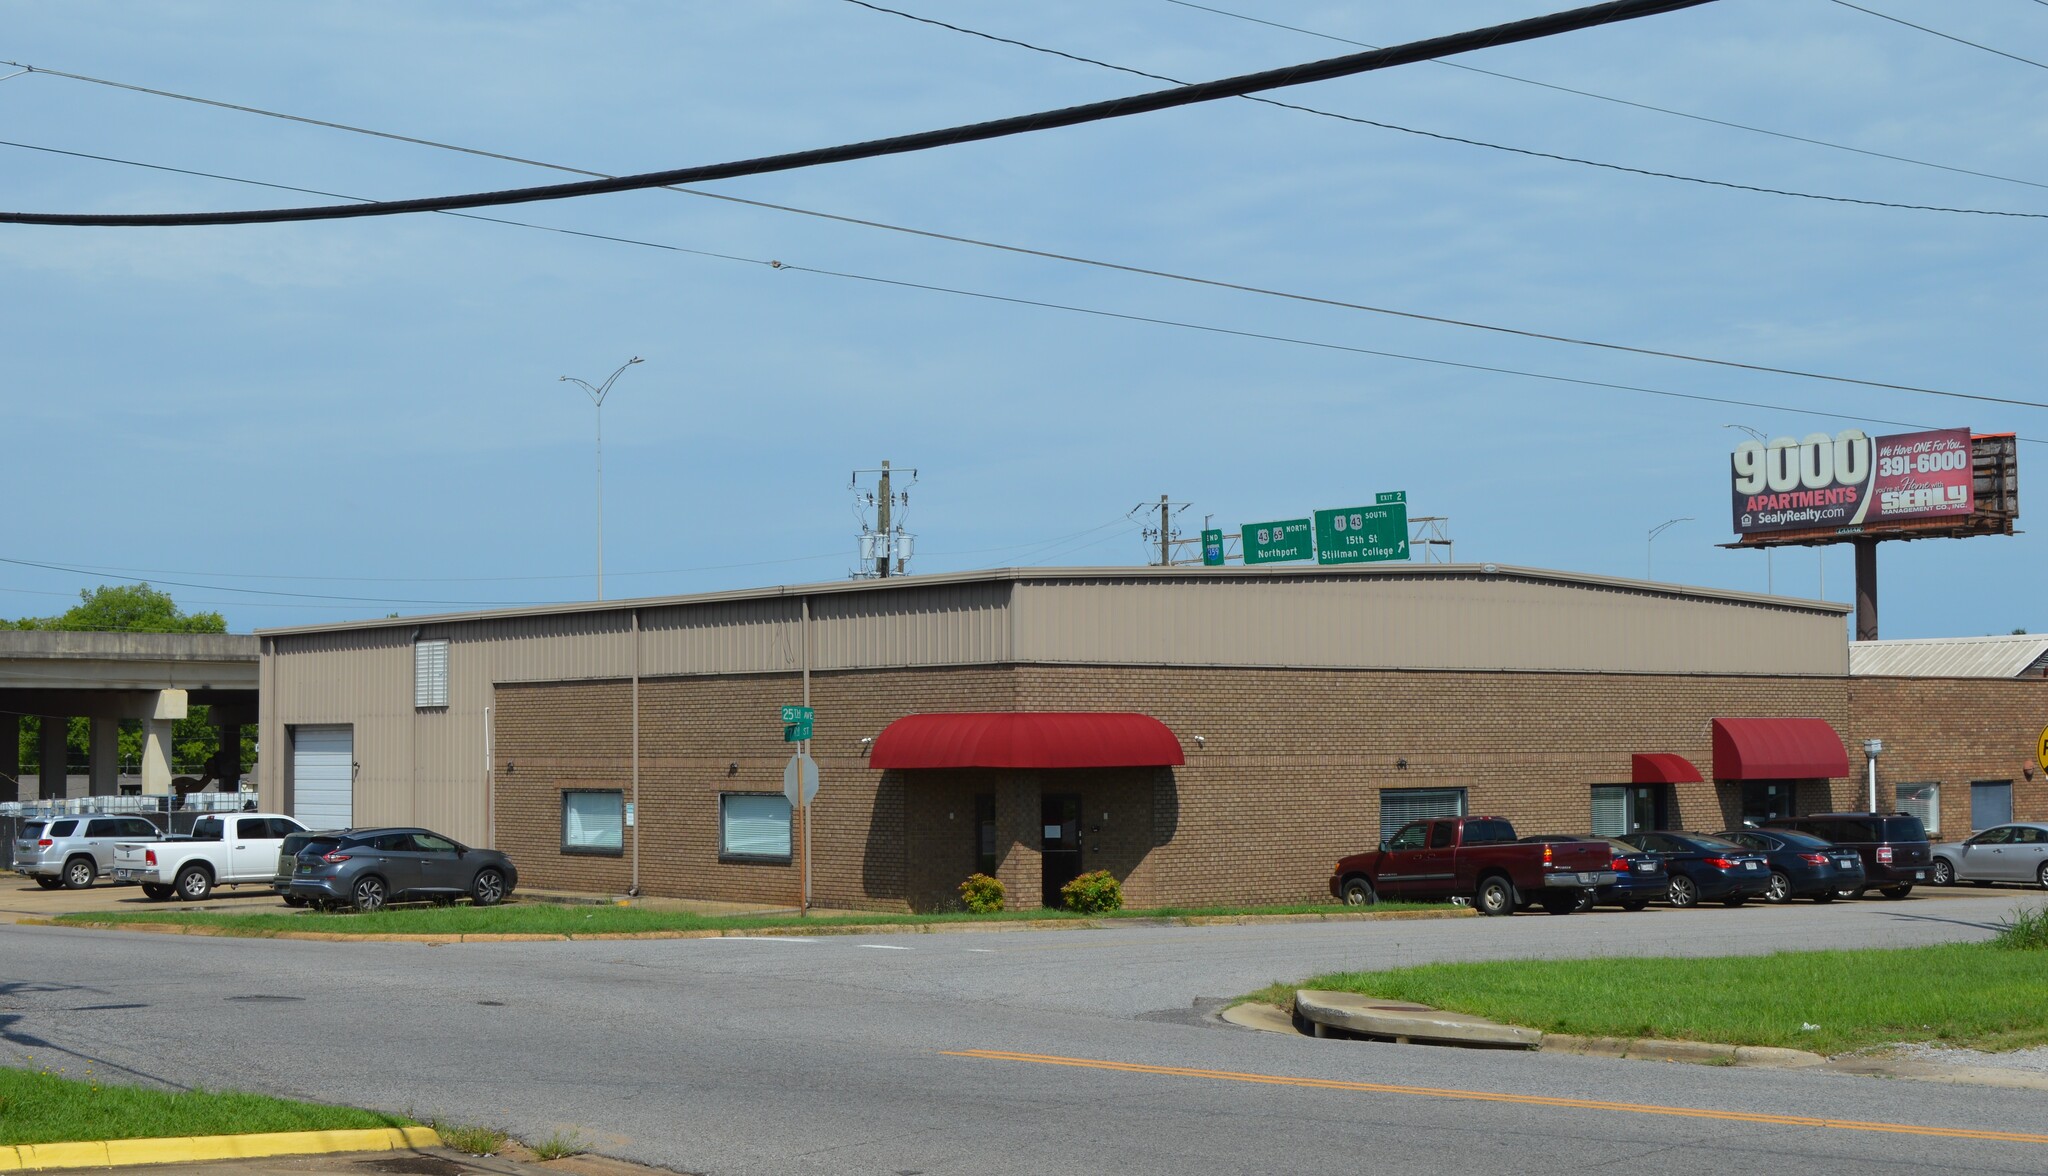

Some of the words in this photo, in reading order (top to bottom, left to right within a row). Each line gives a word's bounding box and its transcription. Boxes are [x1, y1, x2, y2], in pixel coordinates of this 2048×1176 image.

[1880, 446, 1892, 456] We
[1893, 445, 1912, 455] Have
[1913, 441, 1932, 452] ONE
[1932, 440, 1946, 451] For
[1946, 438, 1965, 449] You...
[1733, 429, 1869, 495] 9000
[1879, 450, 1966, 477] 391-6000
[1900, 476, 1930, 495] Home
[1396, 492, 1402, 501] 2
[1746, 486, 1857, 512] APARTMENTS
[1758, 508, 1845, 525] SealyRealty.com
[1881, 505, 1934, 515] MANAGEMENT
[1337, 519, 1344, 528] 11
[1351, 517, 1362, 527] 43
[1365, 511, 1387, 519] SOUTH
[1258, 532, 1268, 541] 43
[1273, 530, 1283, 540] 69
[1286, 524, 1307, 533] NORTH
[1346, 535, 1364, 544] 15th
[1368, 534, 1378, 543] St
[1258, 547, 1297, 558] Northport
[1321, 550, 1358, 559] Stillman
[1362, 547, 1394, 558] College
[783, 708, 801, 720] 25TH
[804, 711, 813, 720] AVE
[803, 727, 809, 735] ST
